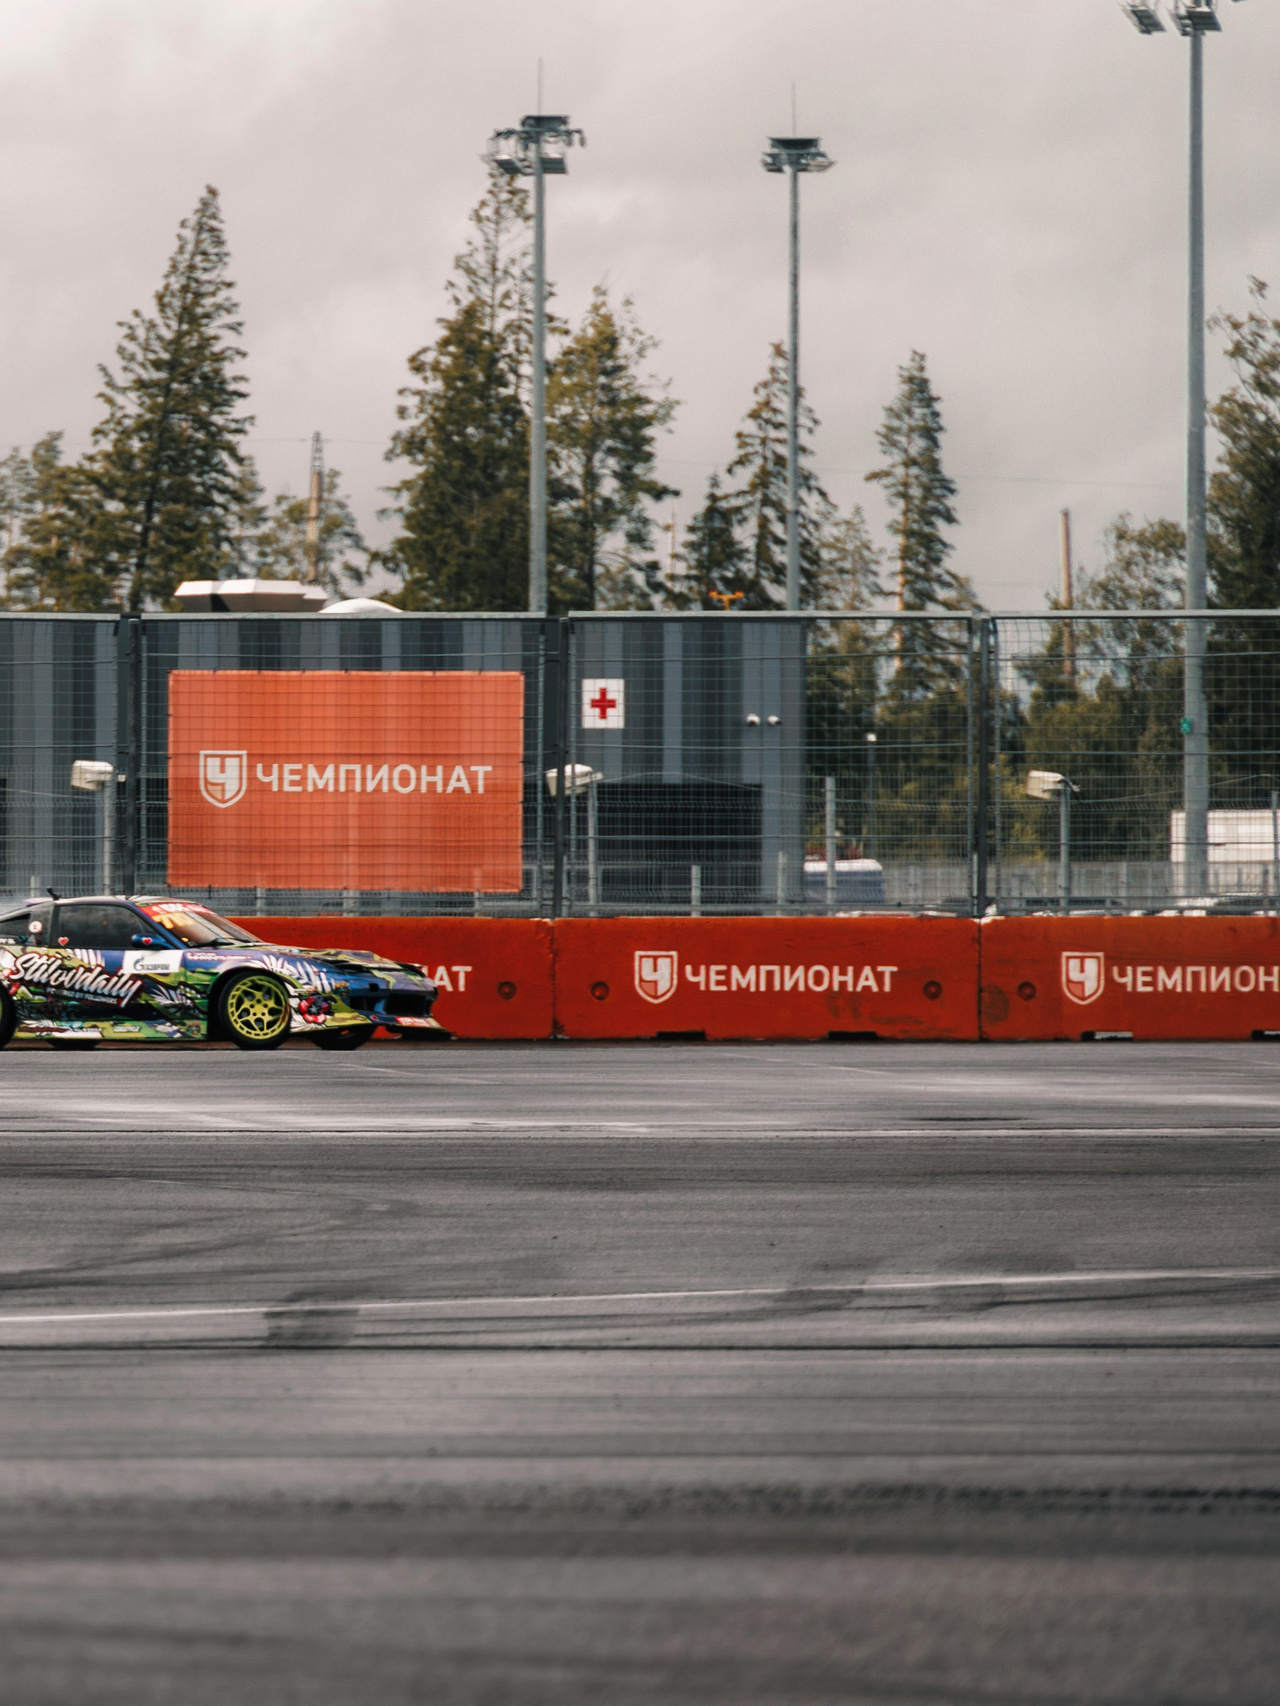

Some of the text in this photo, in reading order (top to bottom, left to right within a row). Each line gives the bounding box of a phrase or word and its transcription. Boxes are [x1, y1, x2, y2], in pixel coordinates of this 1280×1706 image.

[255, 763, 493, 794] ЧЕМПИОНАТ
[684, 965, 899, 992] ЧЕМПИОНАТ
[1111, 965, 1280, 992] ЧЕМПИОН
